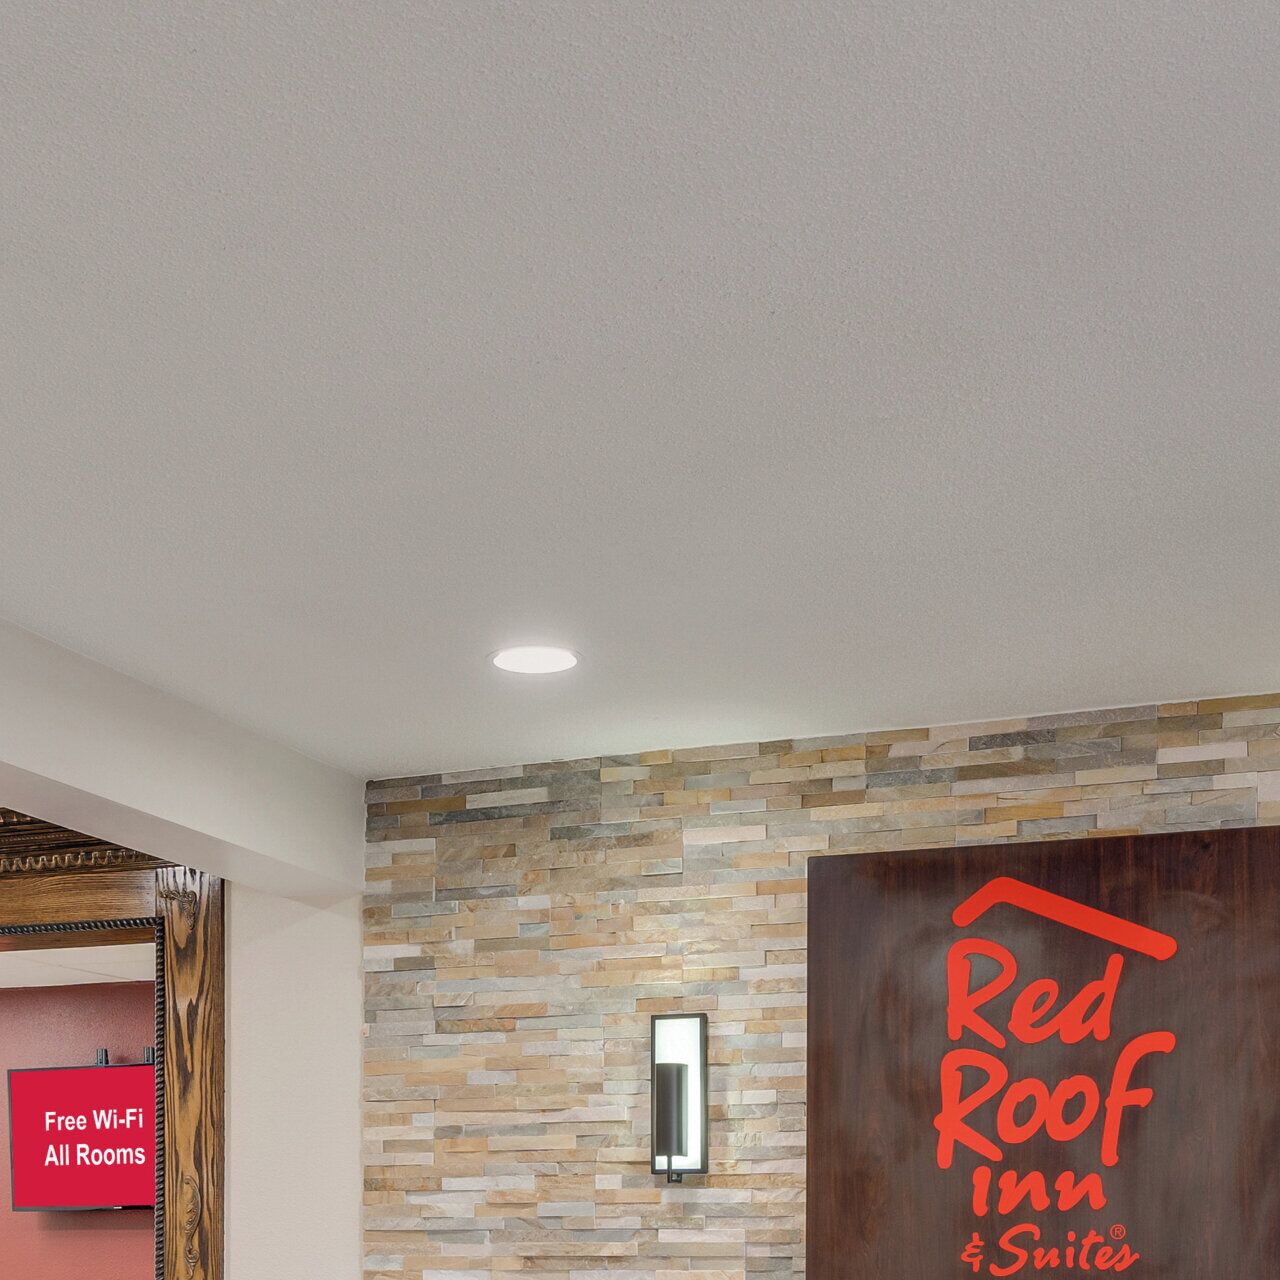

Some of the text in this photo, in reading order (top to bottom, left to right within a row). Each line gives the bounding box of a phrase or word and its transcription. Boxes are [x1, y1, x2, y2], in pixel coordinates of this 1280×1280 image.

[946, 937, 1124, 1049] Red
[44, 1108, 144, 1131] Free Wi-Fi
[933, 1031, 1177, 1169] Roof
[44, 1143, 146, 1166] All Rooms
[960, 1222, 1141, 1277] & Suites
